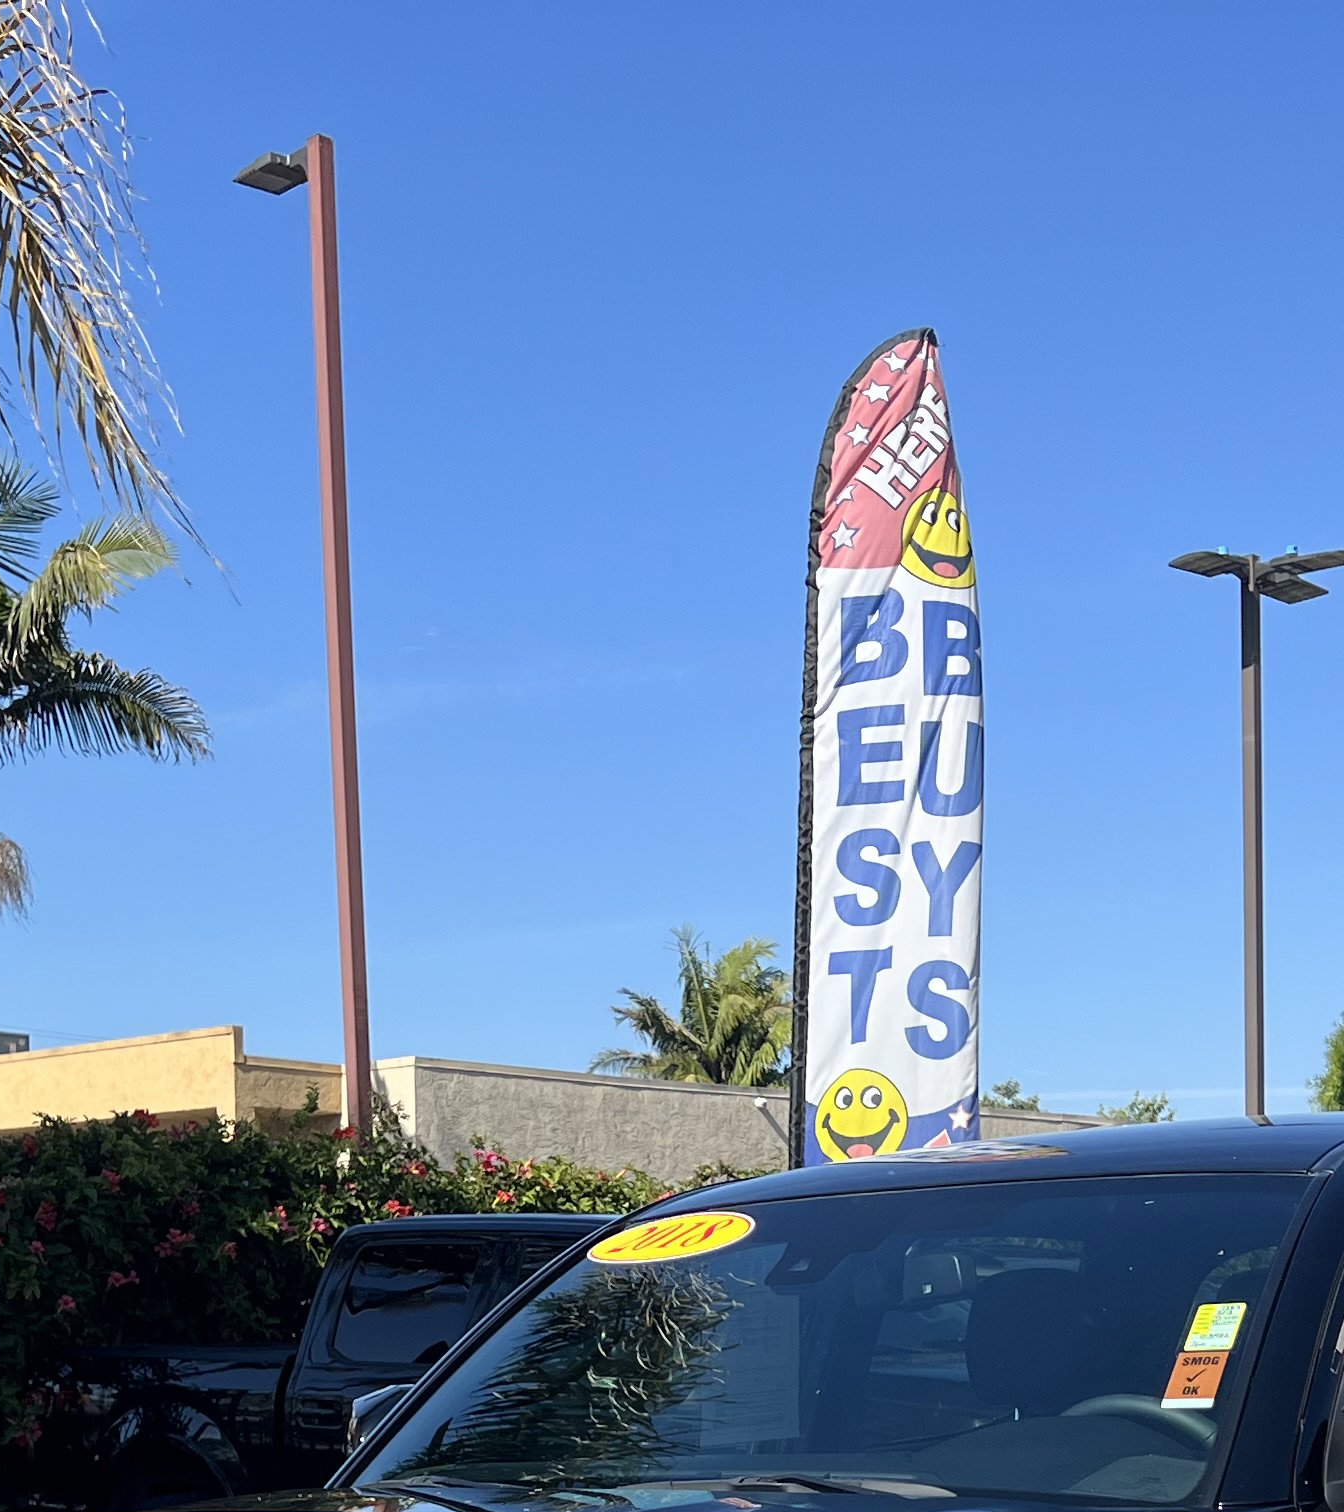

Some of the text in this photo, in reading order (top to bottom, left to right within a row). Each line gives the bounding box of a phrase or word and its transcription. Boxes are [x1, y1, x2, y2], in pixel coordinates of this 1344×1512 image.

[855, 383, 951, 510] HERE
[828, 588, 909, 1045] BEST
[905, 600, 984, 1060] BUYS
[605, 1219, 734, 1253] 2018
[1182, 1356, 1220, 1366] SMOG
[1182, 1386, 1200, 1395] OK
